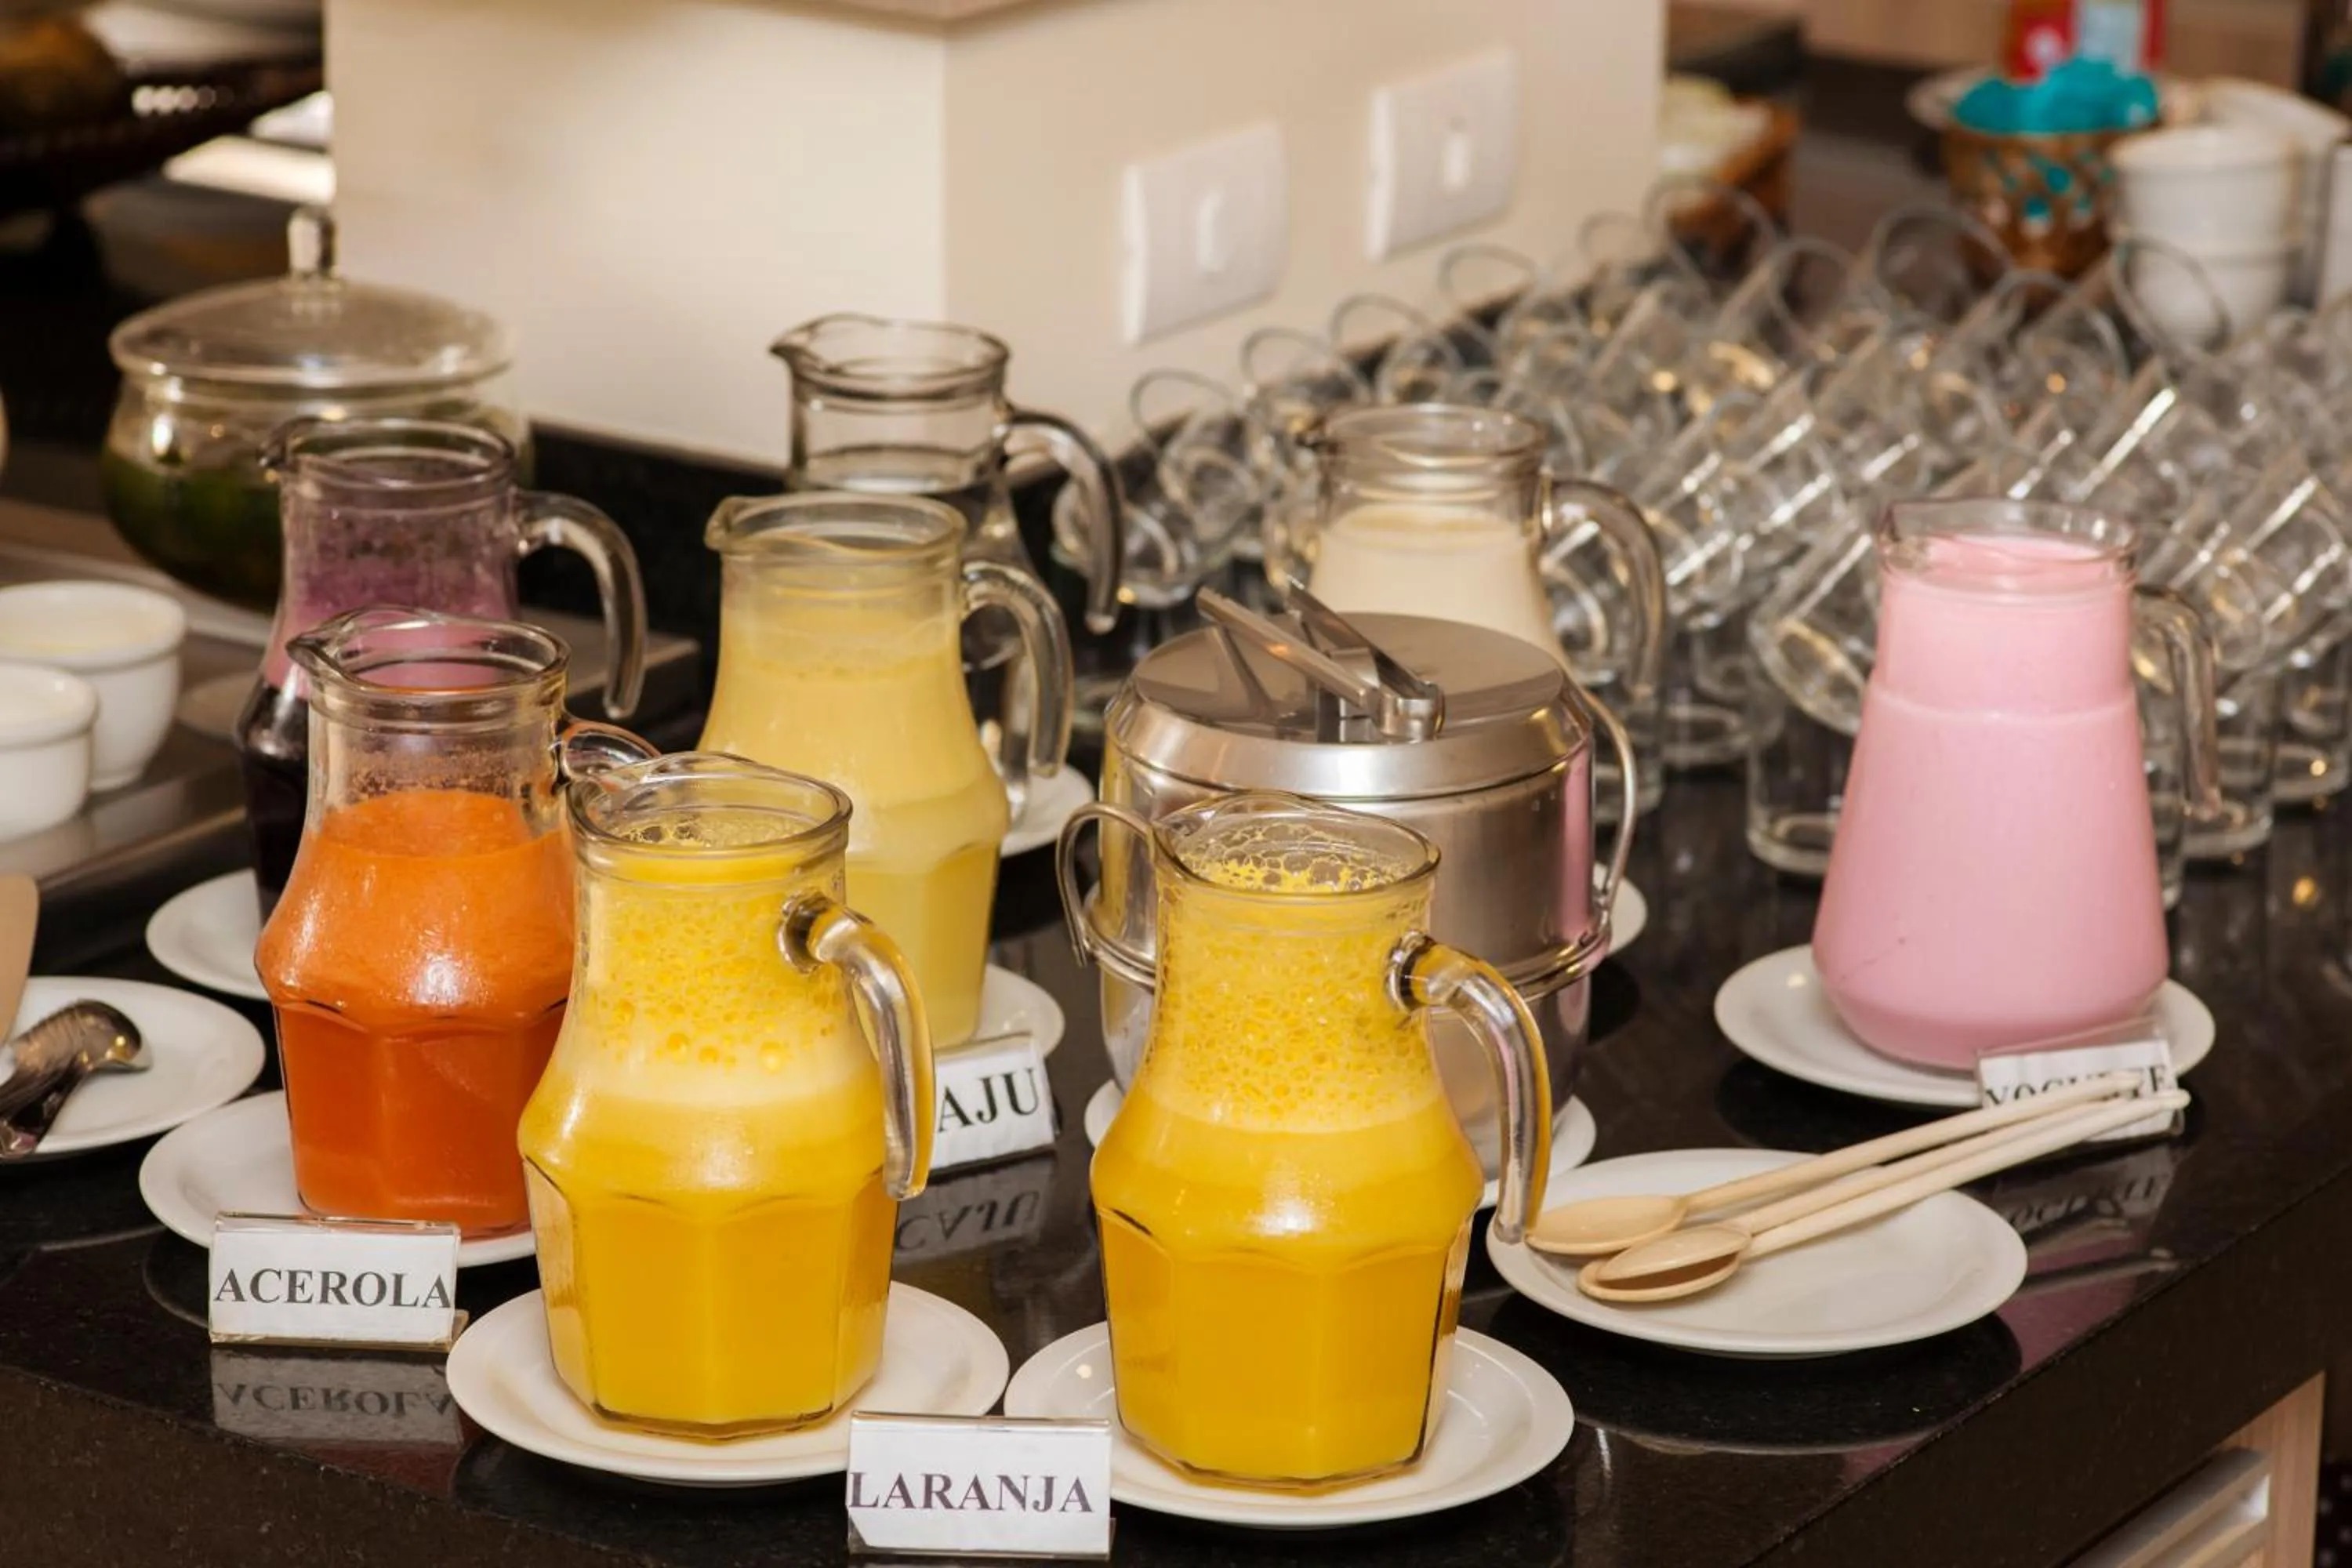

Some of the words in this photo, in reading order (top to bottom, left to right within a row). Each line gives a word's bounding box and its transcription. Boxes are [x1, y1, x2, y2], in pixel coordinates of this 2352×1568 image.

[938, 1067, 1040, 1133] AJU
[214, 1268, 452, 1308] ACEROLA
[848, 1472, 1093, 1513] LARANJA
